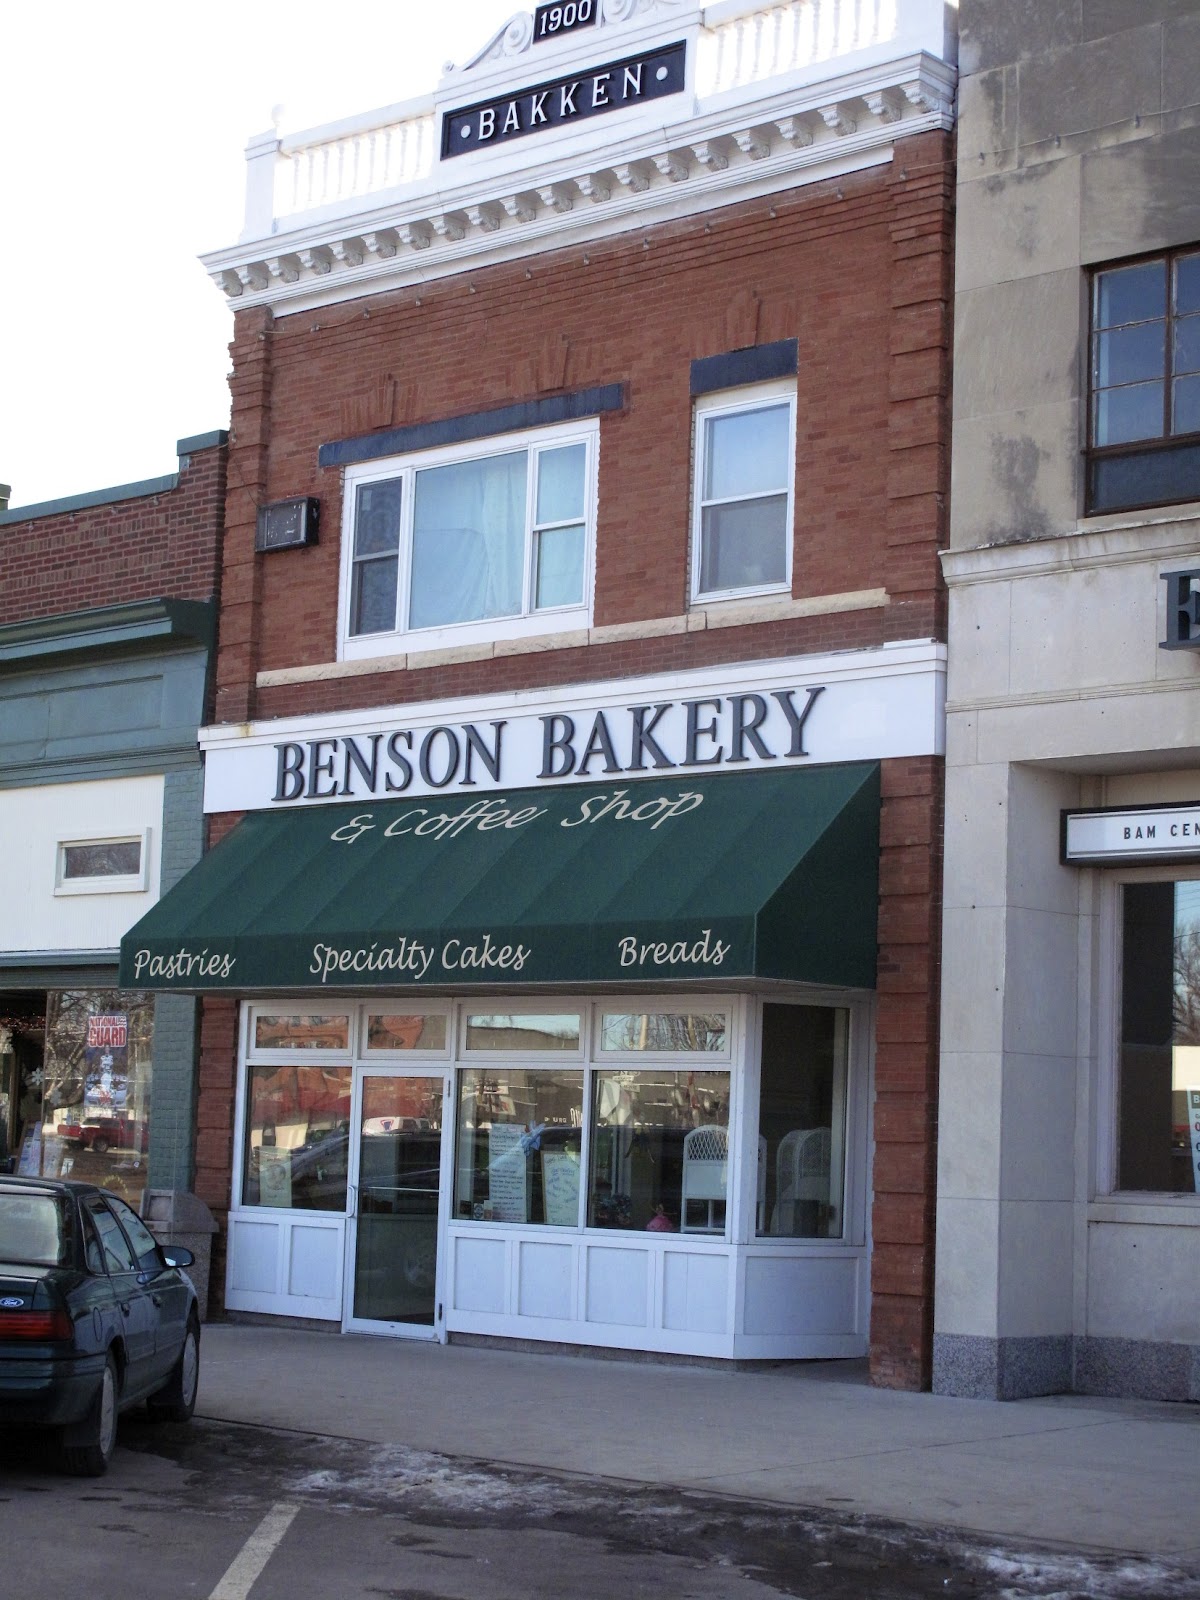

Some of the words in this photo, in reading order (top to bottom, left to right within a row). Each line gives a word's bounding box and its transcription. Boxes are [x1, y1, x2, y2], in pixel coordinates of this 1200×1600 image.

[540, 0, 592, 36] 1900
[477, 63, 643, 140] BAKKEN
[271, 720, 507, 801] BENSON
[536, 687, 826, 779] BAKERY
[331, 814, 376, 844] &
[384, 799, 548, 841] Coffee
[560, 789, 704, 830] Shop
[1124, 825, 1155, 839] BAM
[134, 948, 236, 979] Pastries
[310, 937, 434, 983] Specialty
[441, 934, 531, 971] Cakes
[618, 929, 731, 966] Breads
[89, 1026, 127, 1047] GUARD
